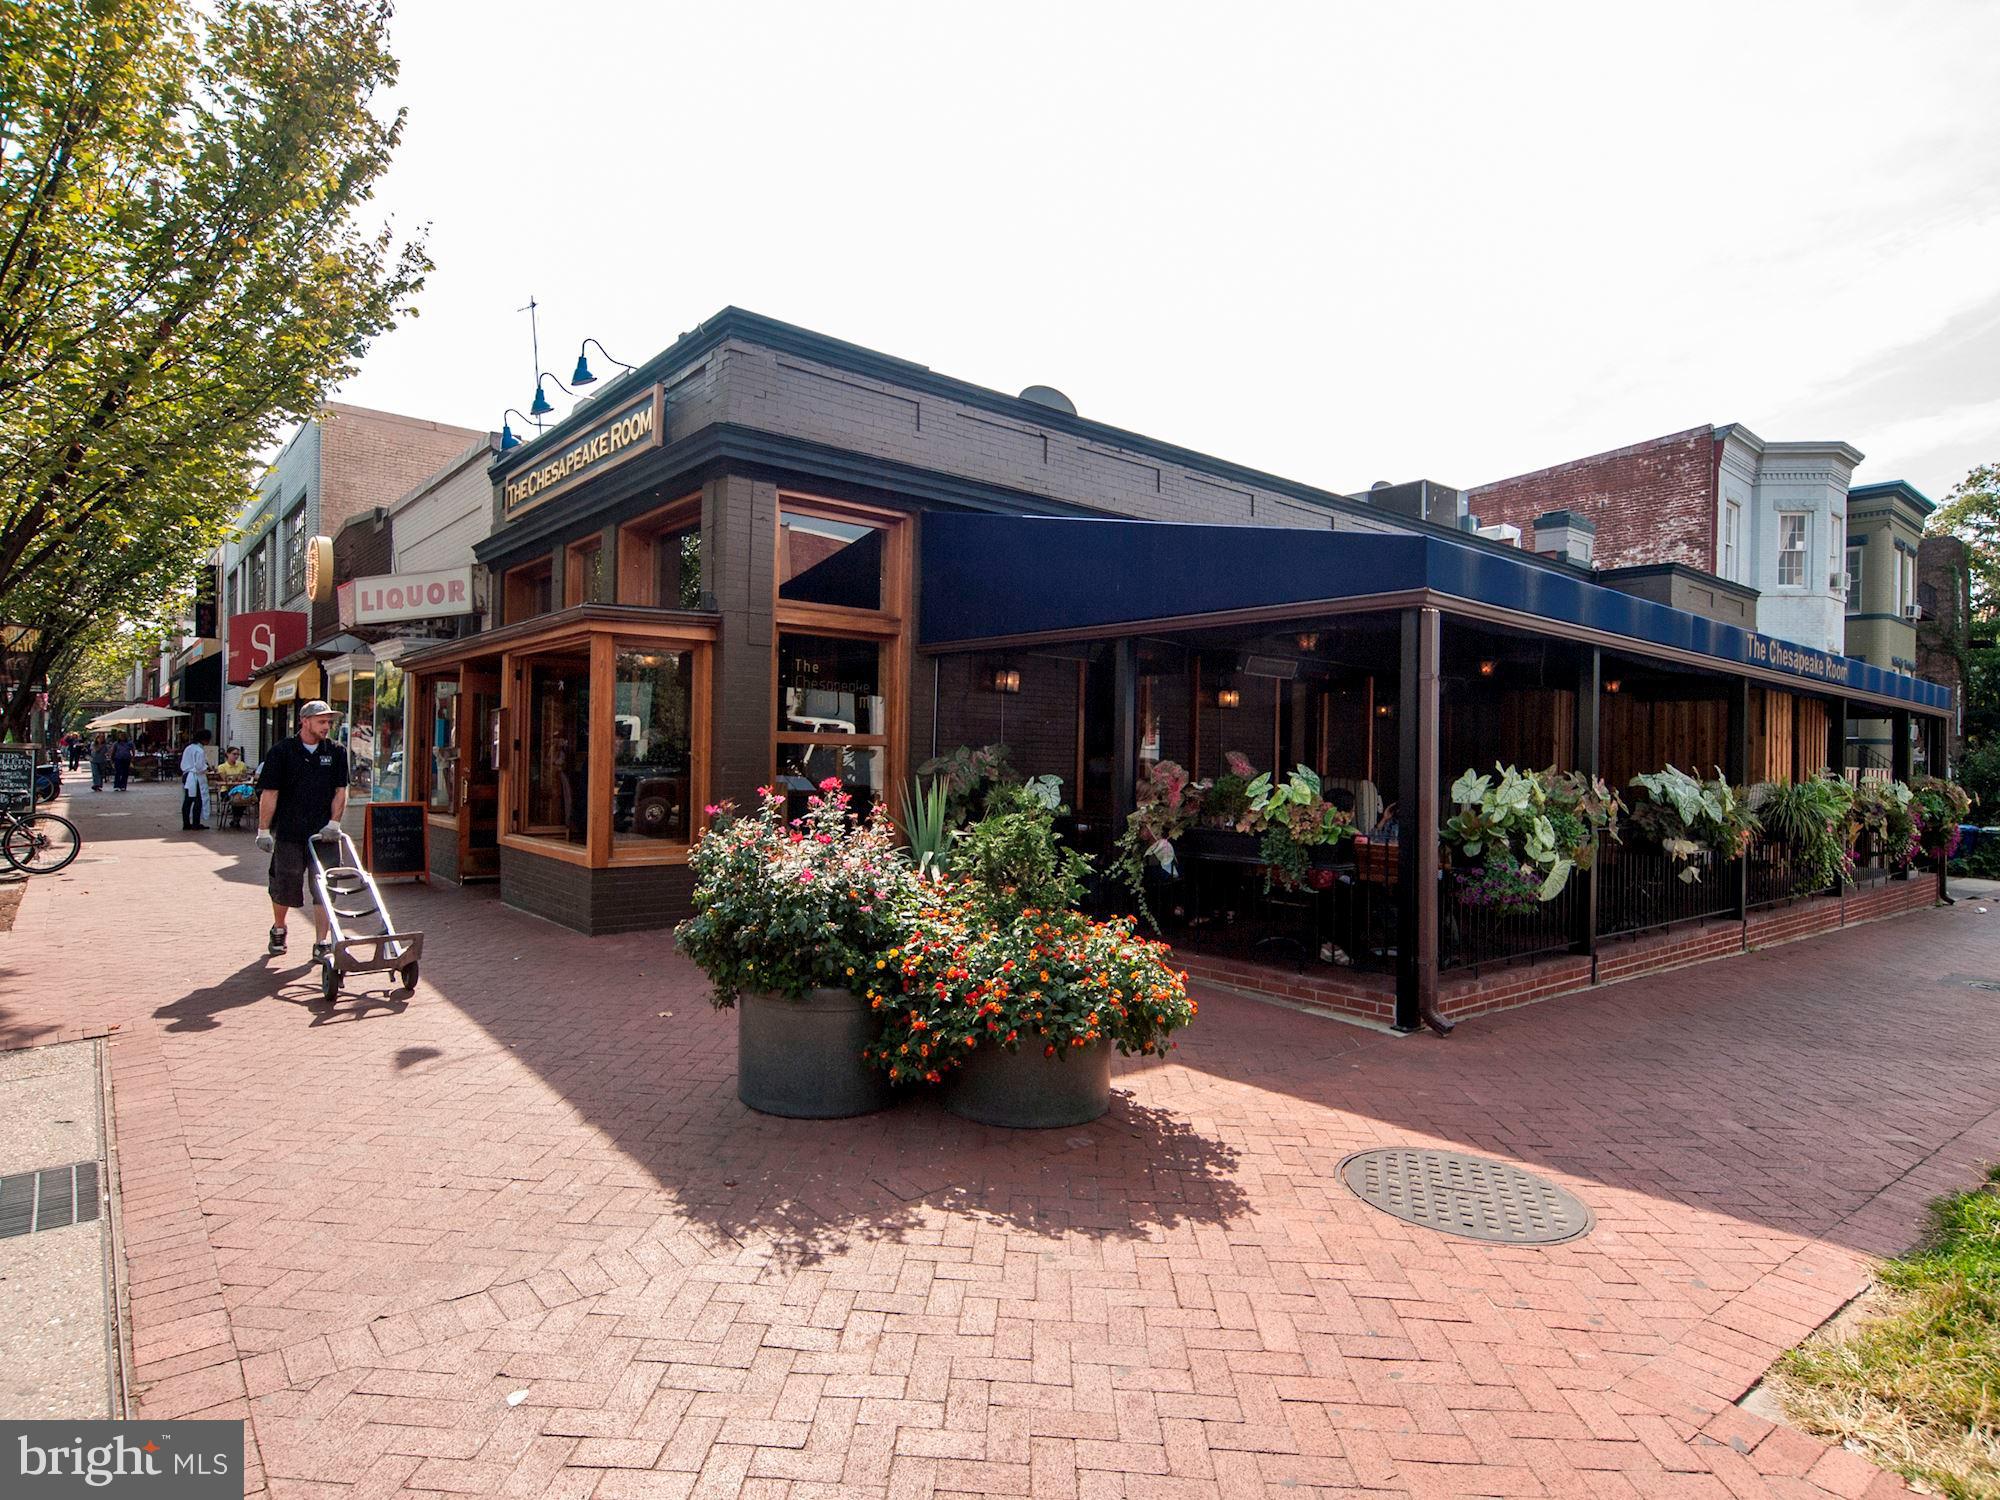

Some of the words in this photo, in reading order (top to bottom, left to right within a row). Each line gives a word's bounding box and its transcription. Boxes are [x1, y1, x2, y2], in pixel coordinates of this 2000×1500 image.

[508, 478, 528, 507] THE
[528, 432, 609, 496] CHESAPEAKE
[610, 406, 653, 452] ROOM
[361, 580, 466, 611] LIQUOR
[795, 658, 820, 673] The
[1747, 633, 1766, 660] The
[1769, 640, 1824, 675] Chesapeake
[1826, 656, 1848, 680] Room
